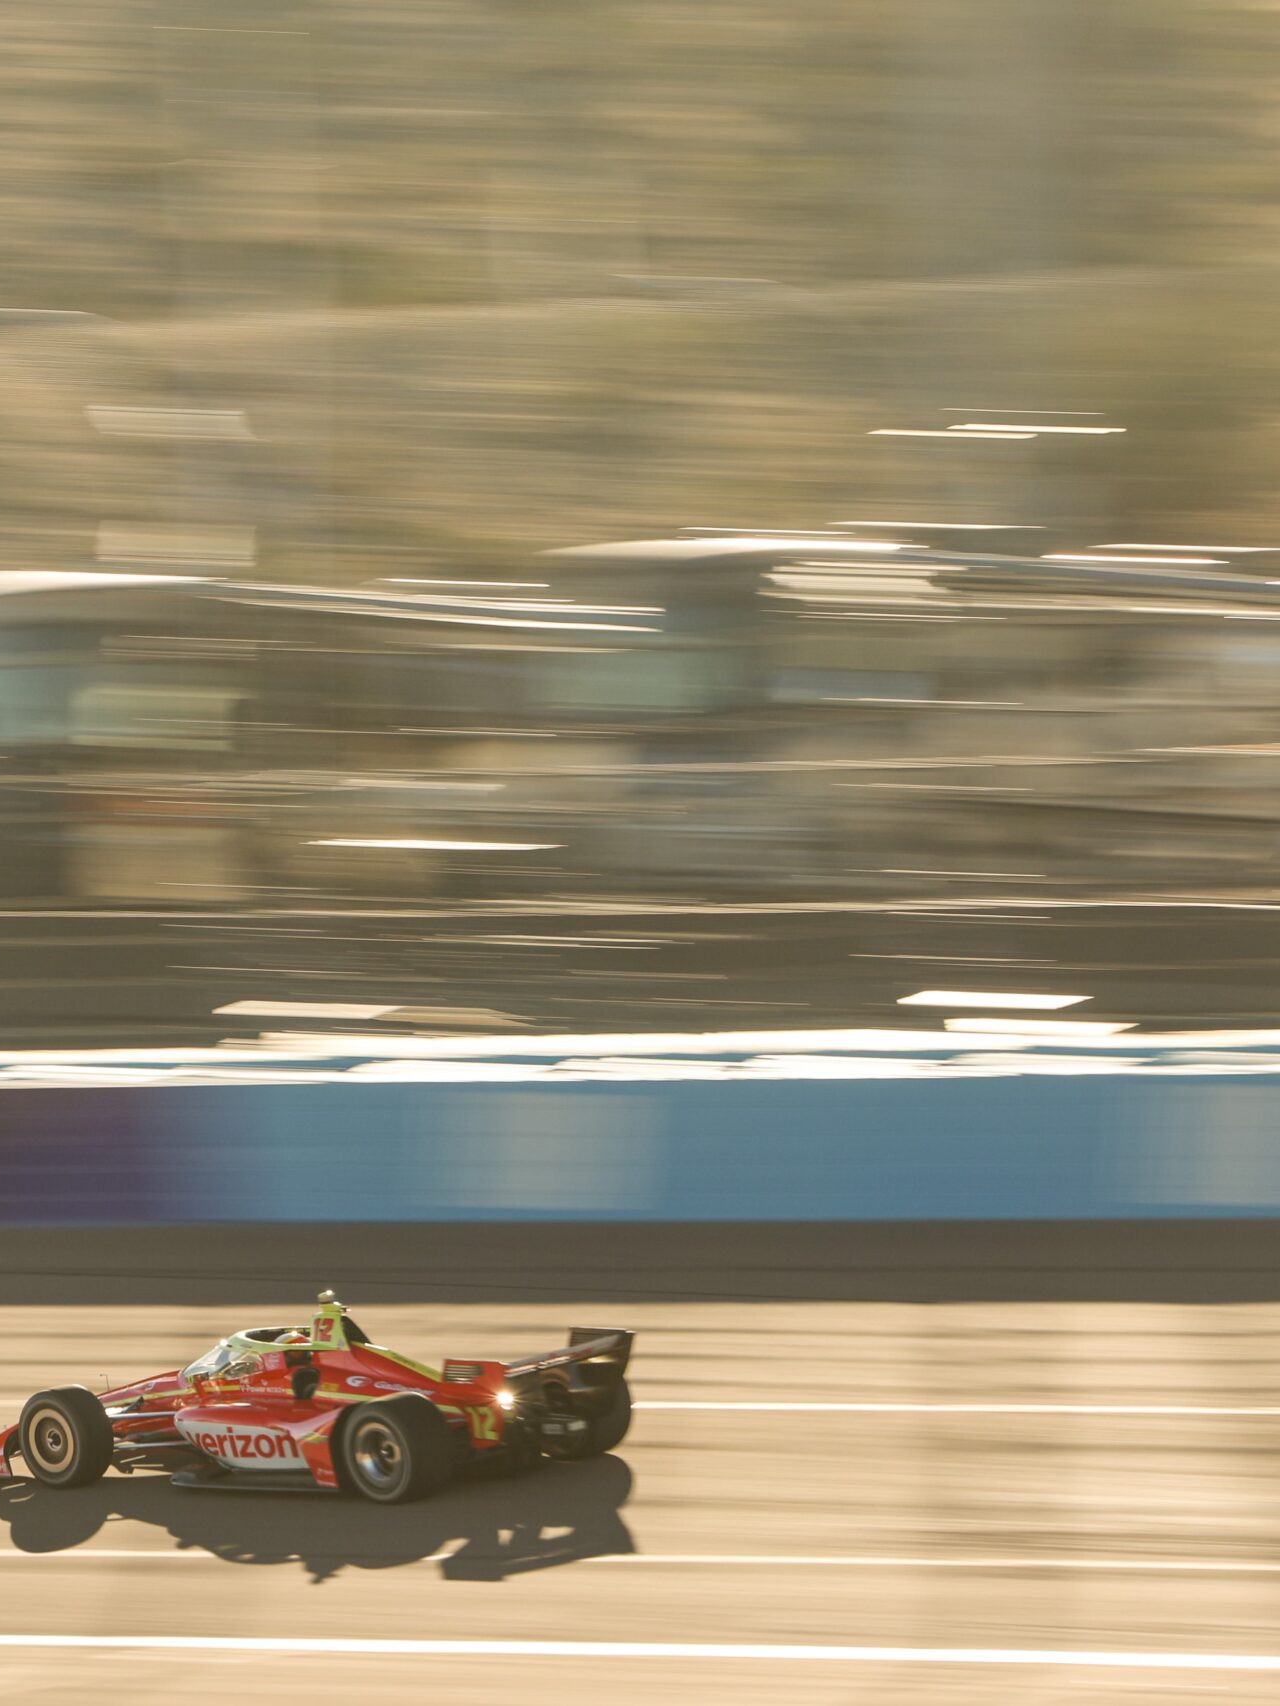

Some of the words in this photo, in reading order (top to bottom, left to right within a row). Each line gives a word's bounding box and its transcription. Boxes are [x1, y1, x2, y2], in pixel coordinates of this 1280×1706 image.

[313, 1317, 335, 1342] 12
[465, 1405, 500, 1441] 12
[186, 1426, 300, 1458] verizon
